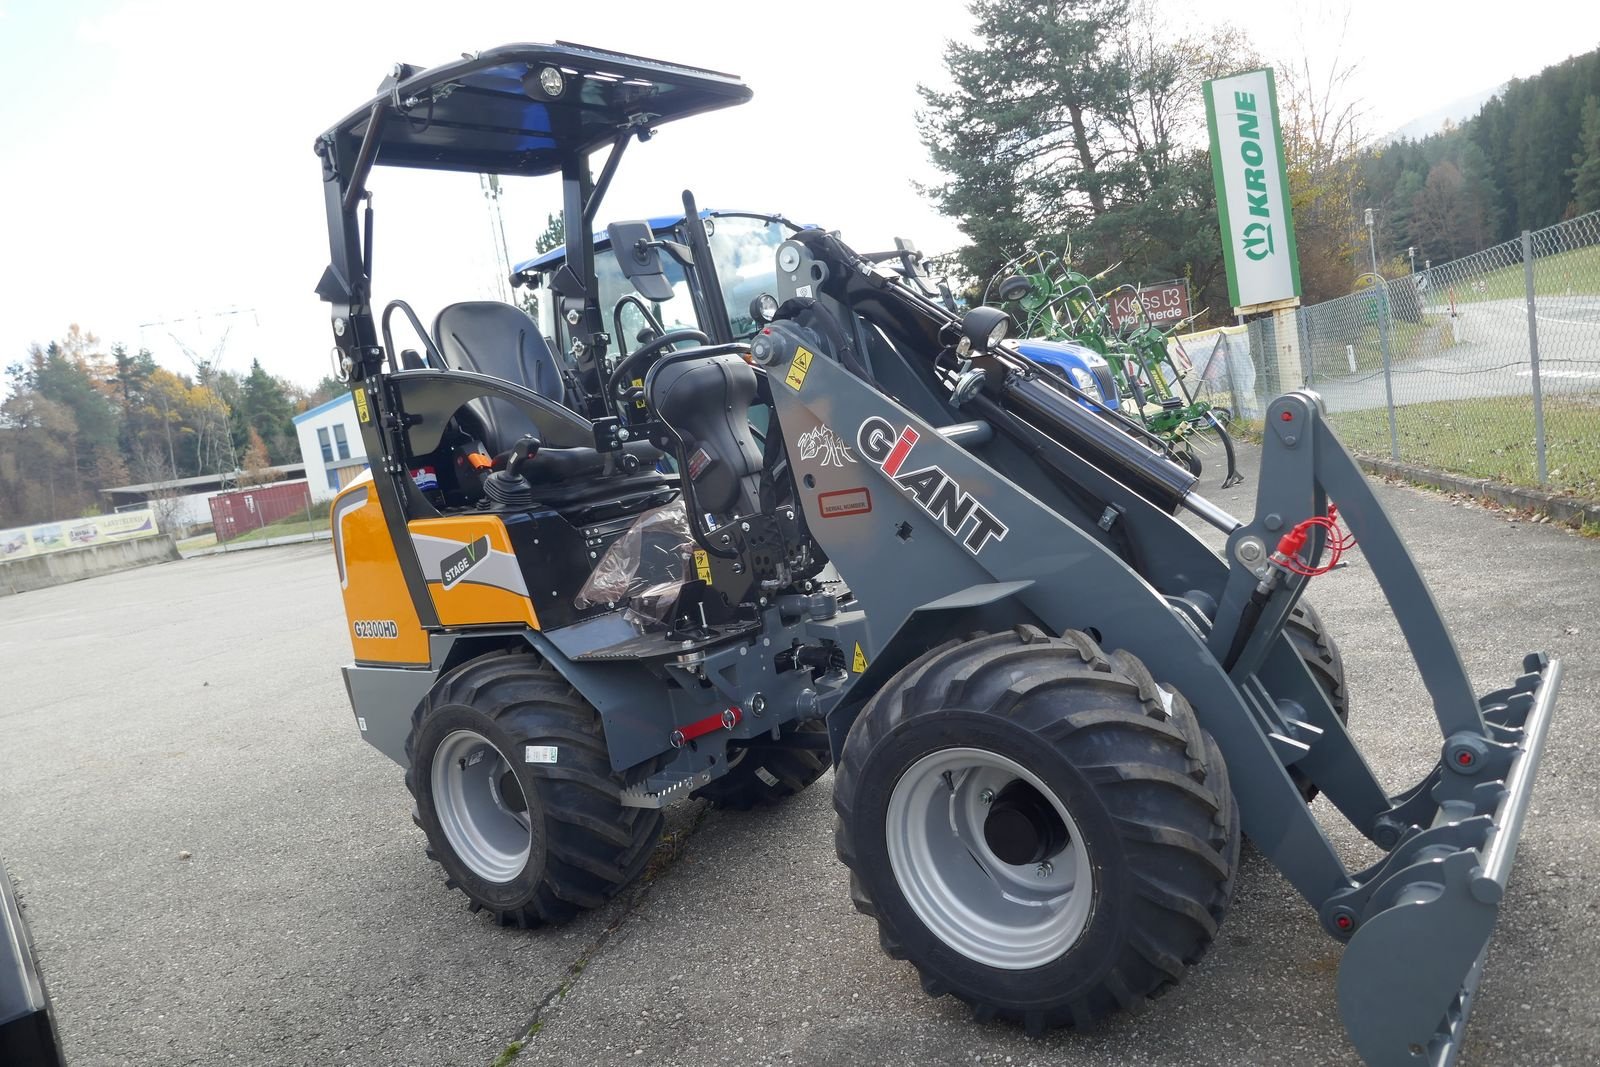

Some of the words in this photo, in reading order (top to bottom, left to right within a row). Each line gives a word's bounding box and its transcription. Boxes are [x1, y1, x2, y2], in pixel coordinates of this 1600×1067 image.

[1234, 91, 1270, 218] KRONE
[445, 557, 470, 581] STAGE
[354, 620, 398, 638] G2300HD
